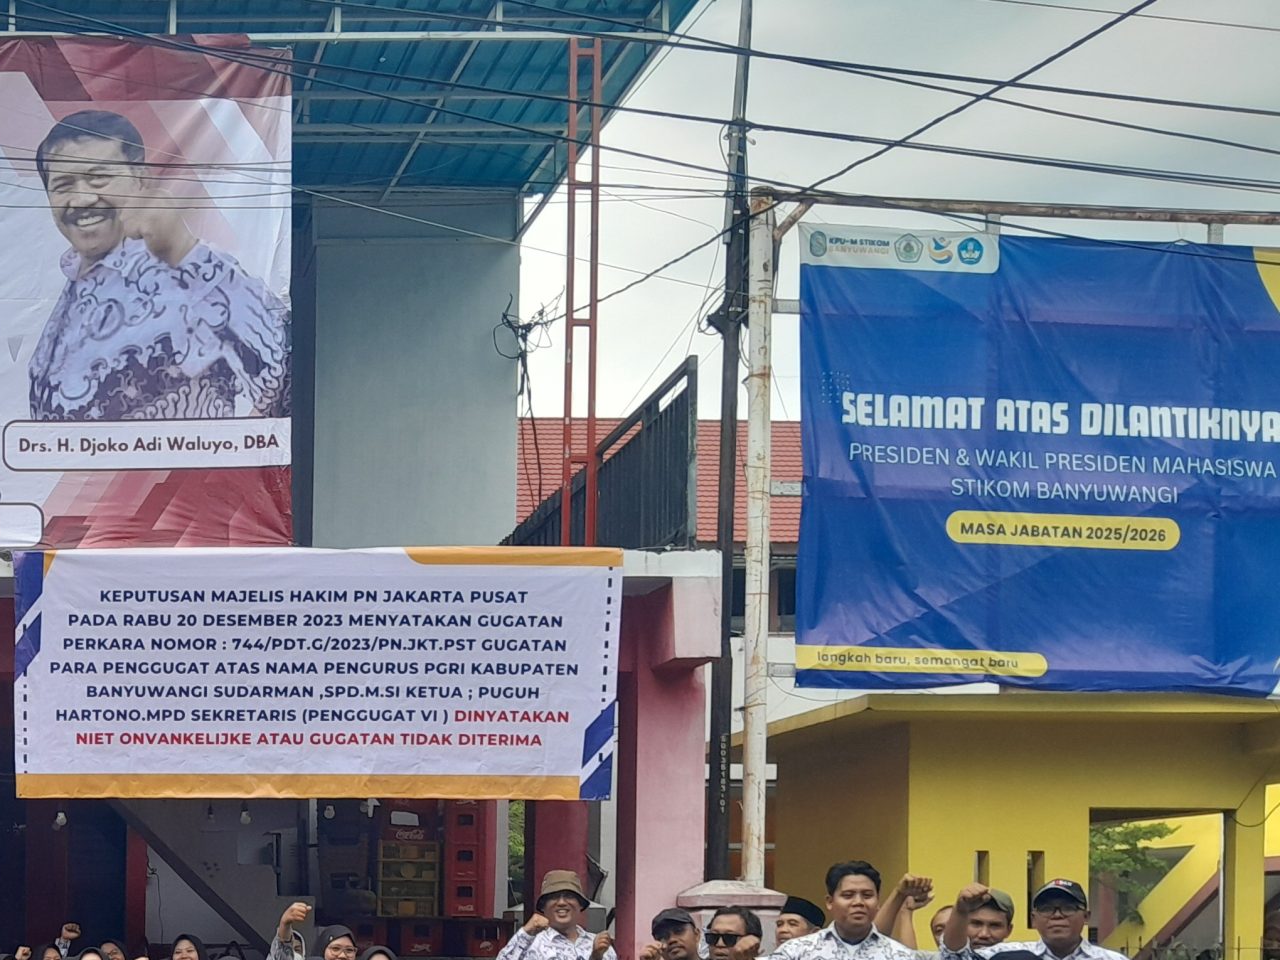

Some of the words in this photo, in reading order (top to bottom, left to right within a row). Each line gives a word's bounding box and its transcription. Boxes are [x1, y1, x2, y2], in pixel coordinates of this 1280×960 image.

[859, 238, 890, 247] STIKOM
[842, 391, 985, 430] SELAMAT
[996, 399, 1069, 434] ATAS
[1081, 402, 1280, 443] DILANTIKNYA
[19, 438, 51, 453] Drs.
[57, 438, 74, 453] H.
[80, 437, 129, 456] Djoko
[133, 437, 162, 451] Adi
[167, 436, 238, 455] Waluyo,
[244, 434, 279, 449] DBA
[850, 443, 949, 466] PRESIDEN
[956, 449, 970, 466] &
[975, 449, 1039, 469] WAKIL
[1045, 452, 1146, 473] PRESIDEN
[1153, 456, 1277, 479] MAHASISWA
[951, 478, 1030, 498] STIKOM
[1037, 482, 1178, 504] BANYUWANGI
[960, 523, 1006, 536] MASA
[1011, 524, 1083, 539] JABATAN
[1087, 525, 1166, 543] 2025/2026
[100, 590, 205, 602] KEPUTUSAN
[211, 590, 284, 602] MAJELIS
[290, 590, 347, 602] HAKIM
[354, 590, 377, 602] PN
[383, 590, 464, 603] JAKARTA
[470, 591, 528, 603] PUSAT
[68, 614, 117, 626] PADA
[123, 614, 171, 626] RABU
[177, 614, 197, 626] 20
[203, 614, 297, 626] DESEMBER
[303, 614, 343, 626] 2023
[349, 614, 472, 627] MENYATAKAN
[477, 615, 563, 627] GUGATAN
[63, 638, 145, 650] PERKARA
[151, 638, 217, 650] NOMOR
[481, 639, 567, 652] GUGATAN
[817, 652, 870, 666] langkah
[875, 653, 910, 666] baru,
[914, 656, 984, 669] semangat
[988, 656, 1019, 669] baru
[50, 662, 97, 674] PARA
[103, 662, 209, 674] PENGGUGAT
[215, 662, 260, 674] ATAS
[266, 662, 318, 674] NAMA
[324, 662, 419, 675] PENGURUS
[425, 662, 465, 675] PGRI
[471, 663, 578, 675] KABUPATEN
[86, 686, 208, 698] BANYUWANGI
[214, 686, 314, 698] SUDARMAN
[406, 686, 463, 698] KETUA
[478, 686, 539, 699] PUGUH
[56, 709, 185, 721] HARTONO.MPD
[191, 709, 296, 721] SEKRETARIS
[302, 709, 416, 724] (PENGGUGAT
[421, 710, 438, 722] VI
[454, 710, 569, 722] DINYATAKAN
[76, 732, 114, 744] NIET
[120, 732, 251, 744] ONVANKELIJKE
[257, 732, 304, 744] ATAU
[309, 733, 394, 745] GUGATAN
[401, 733, 452, 745] TIDAK
[458, 733, 542, 746] DITERIMA
